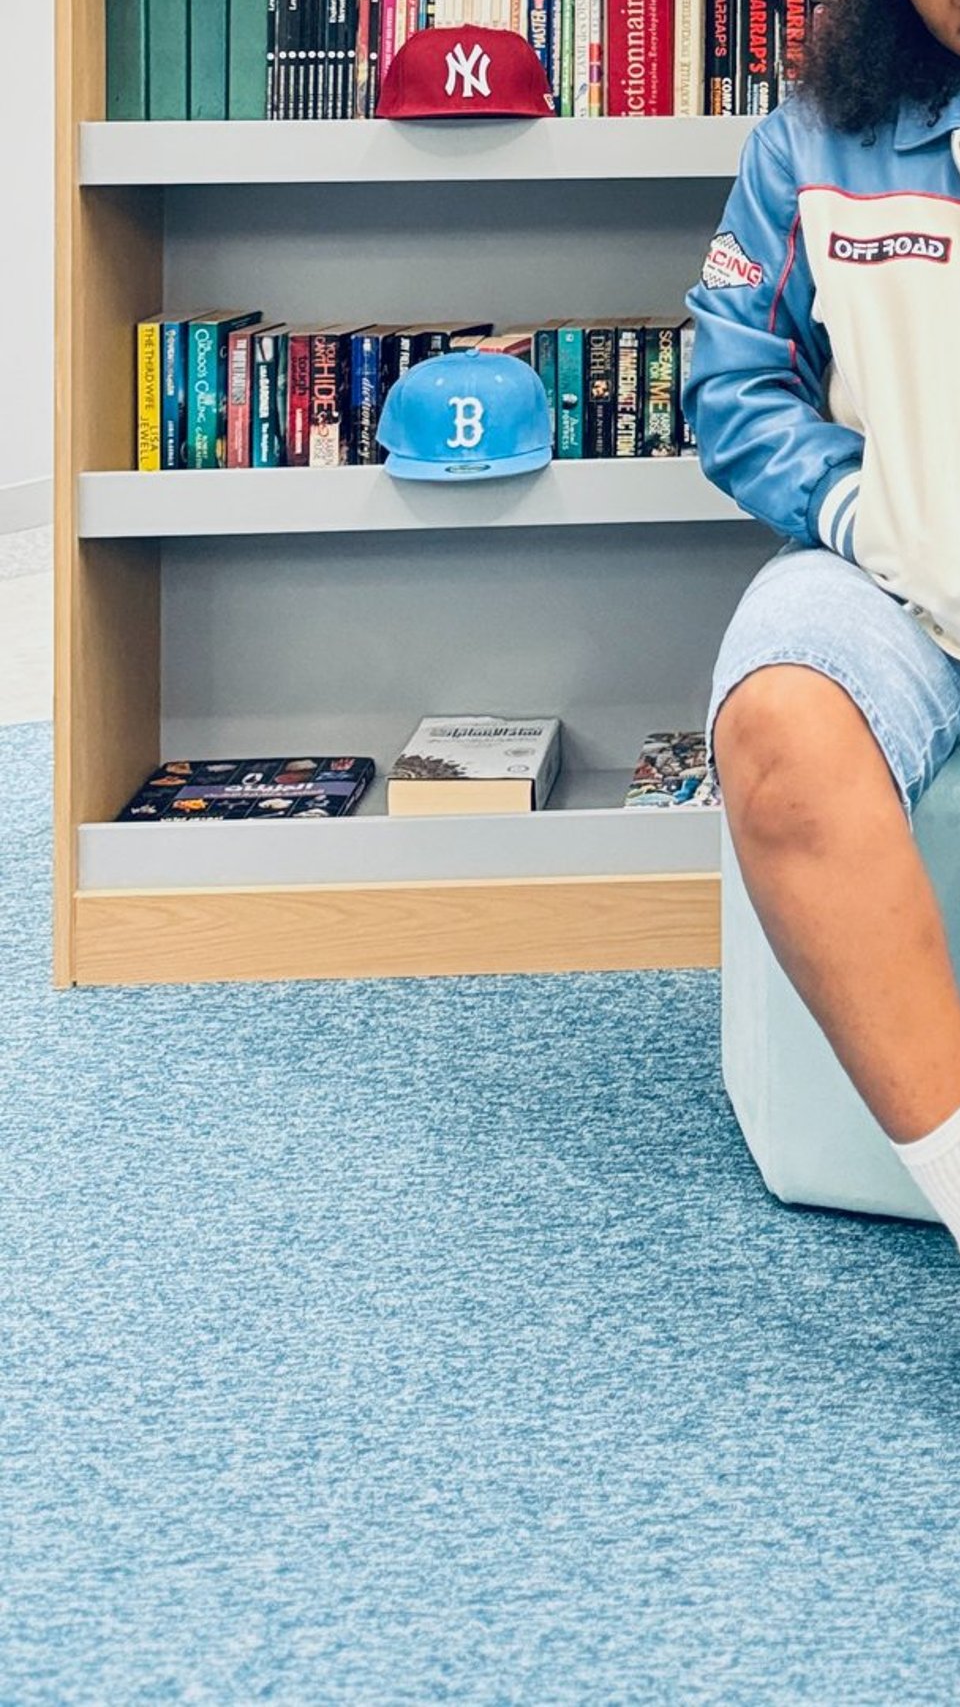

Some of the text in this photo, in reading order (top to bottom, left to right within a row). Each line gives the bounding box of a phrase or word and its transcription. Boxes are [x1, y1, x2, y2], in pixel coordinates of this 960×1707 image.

[531, 9, 546, 48] MASTER
[444, 42, 492, 98] NY
[722, 77, 732, 116] COMPA
[759, 81, 769, 116] COMPA
[706, 250, 762, 285] CING
[834, 236, 945, 260] OFF ROAD
[144, 327, 154, 410] THE THIRD WIFE
[326, 342, 336, 363] YOU
[590, 336, 605, 377] DIEHL
[650, 362, 659, 379] FOR
[659, 330, 672, 380] SCREAM
[297, 357, 308, 396] tough
[314, 363, 336, 413] HIDE
[616, 348, 637, 457] IMMEDIATE ACTION
[649, 382, 671, 412] ME
[140, 416, 149, 463] JEWELL
[150, 425, 159, 452] LISA
[446, 396, 484, 449] B
